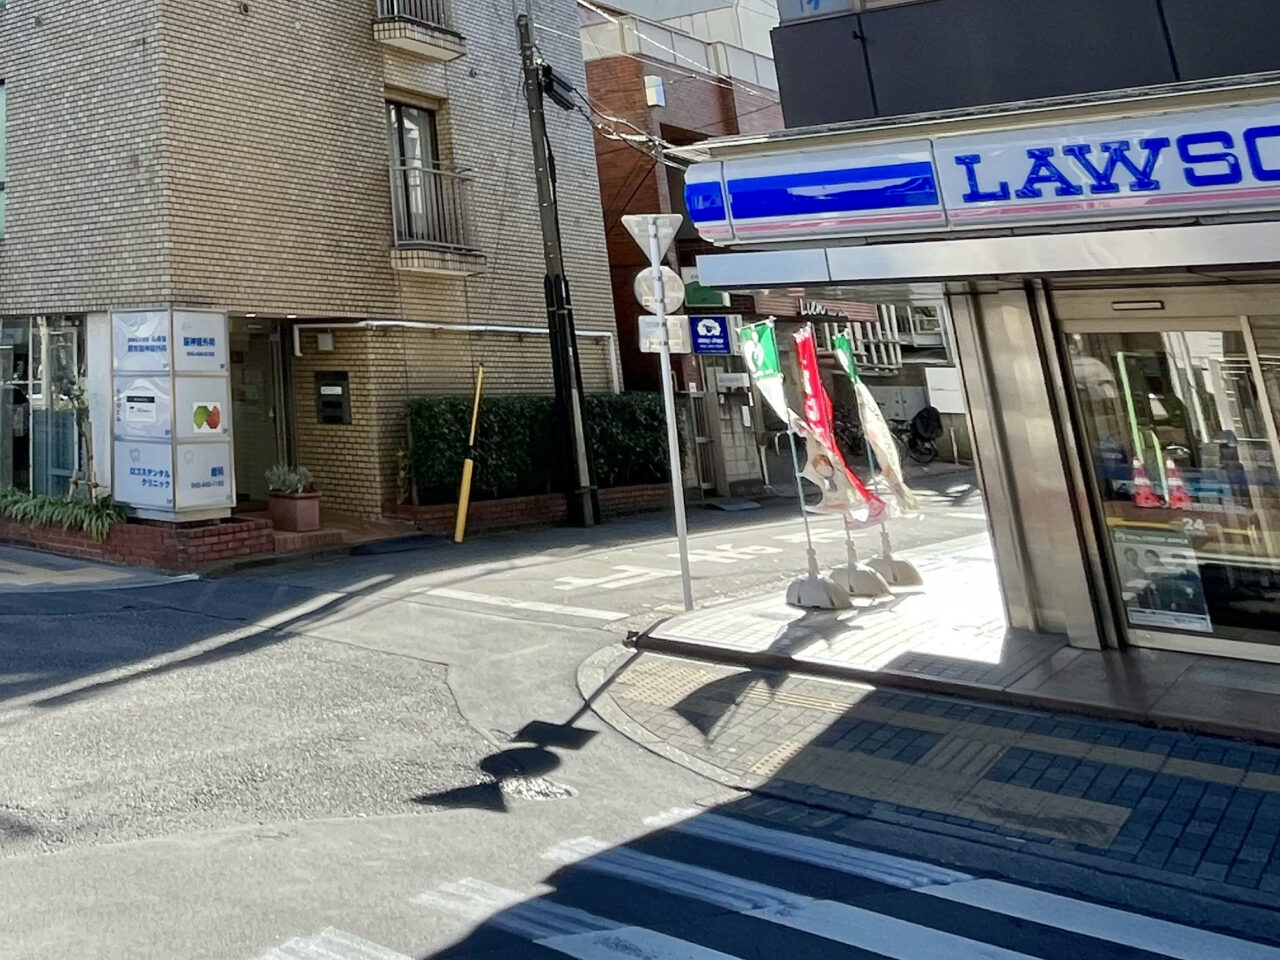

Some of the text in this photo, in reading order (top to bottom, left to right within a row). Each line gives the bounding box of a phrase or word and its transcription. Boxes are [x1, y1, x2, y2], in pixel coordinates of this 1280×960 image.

[141, 478, 170, 489] クリニック
